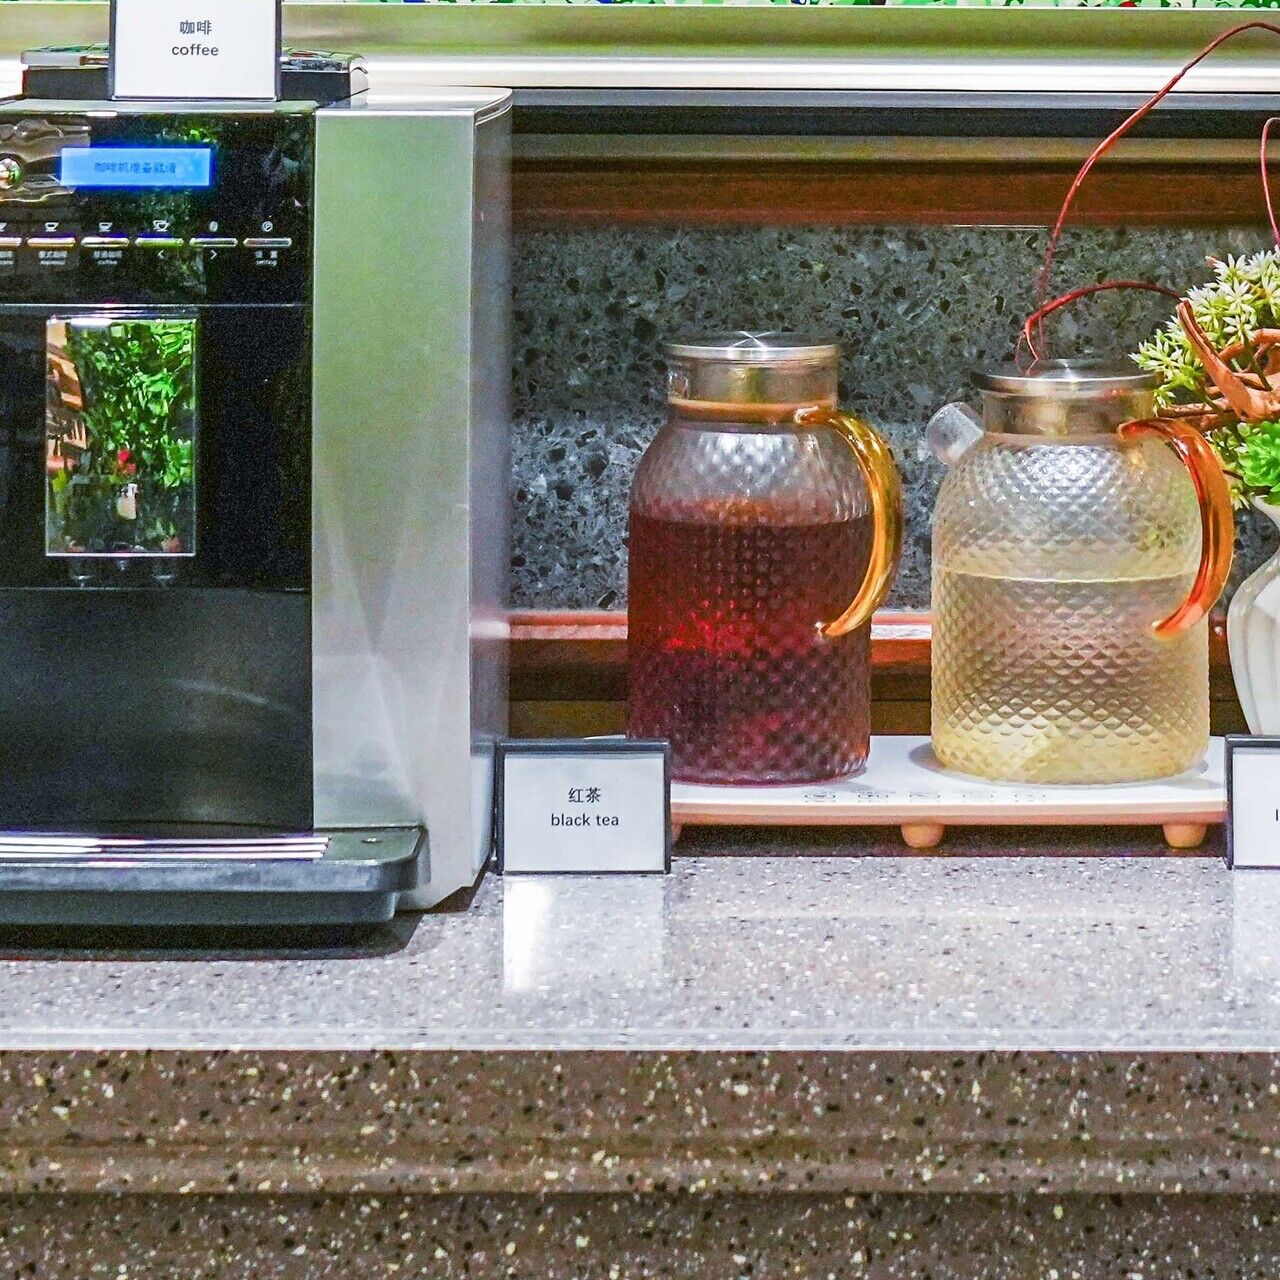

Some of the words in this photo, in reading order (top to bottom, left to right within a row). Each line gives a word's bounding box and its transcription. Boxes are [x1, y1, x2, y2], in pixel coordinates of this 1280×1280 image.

[179, 19, 212, 35] 咖啡
[171, 43, 219, 56] coffee
[568, 787, 602, 803] 红茶
[551, 813, 590, 827] black
[596, 814, 619, 827] tea
